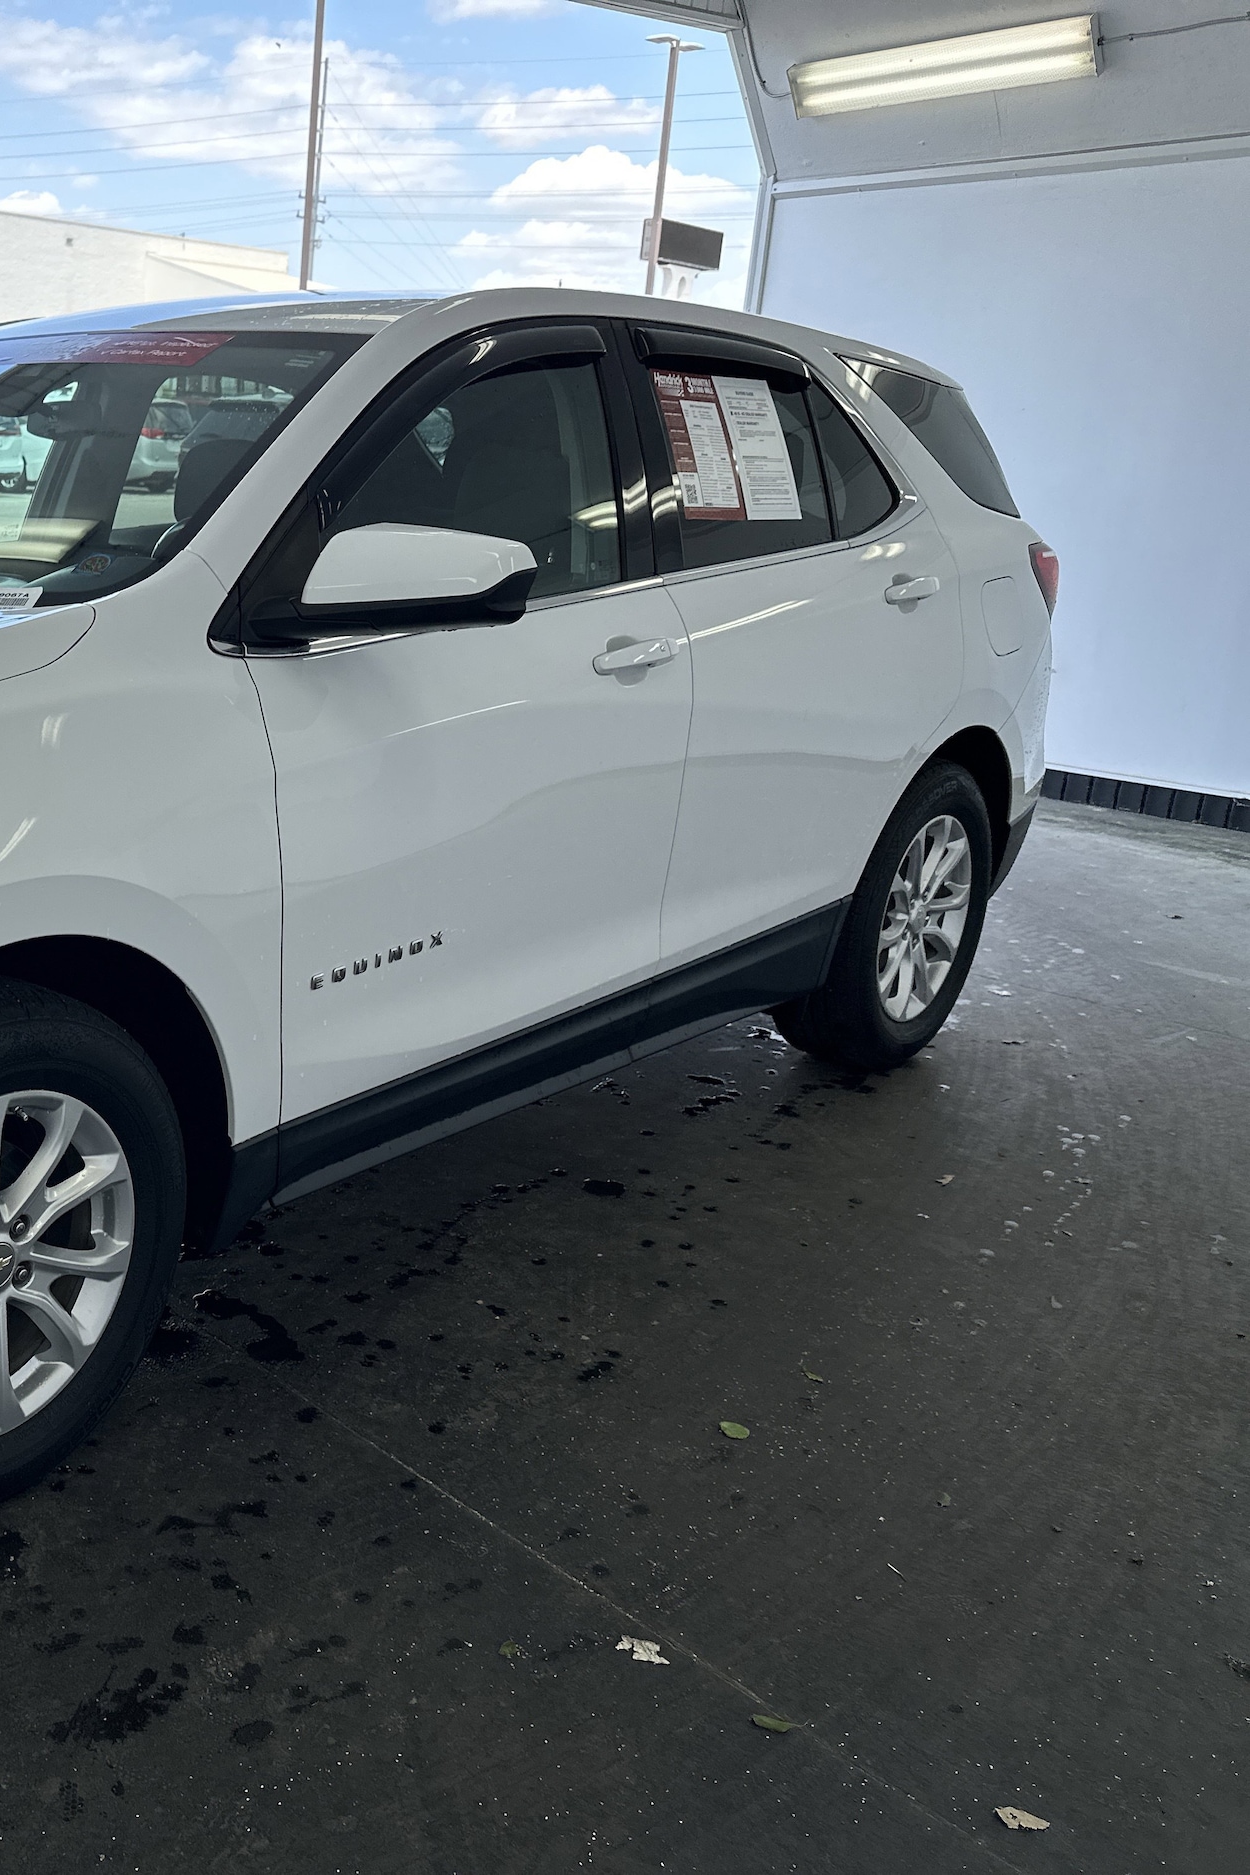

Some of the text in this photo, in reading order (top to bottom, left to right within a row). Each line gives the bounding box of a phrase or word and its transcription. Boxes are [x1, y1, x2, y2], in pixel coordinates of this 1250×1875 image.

[653, 371, 694, 393] Hendrick 3
[310, 931, 444, 991] EQUINOX
